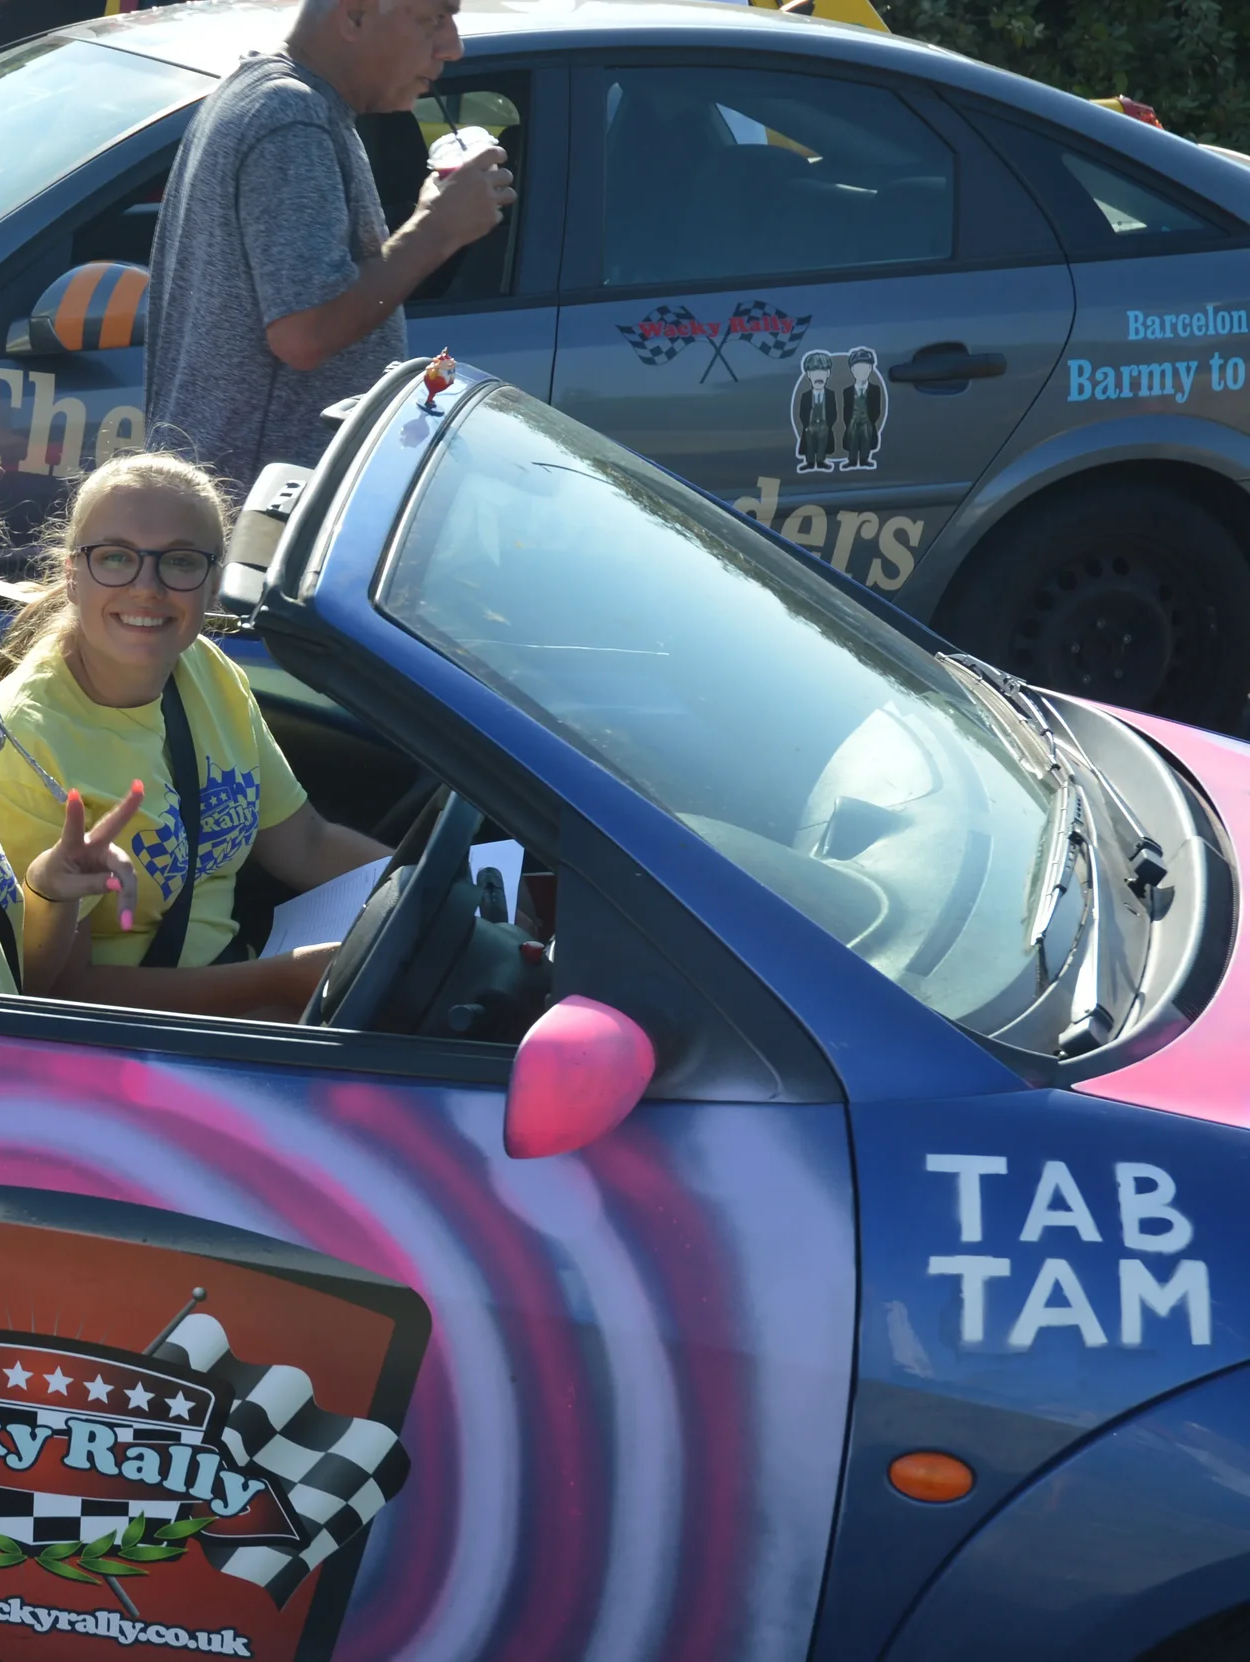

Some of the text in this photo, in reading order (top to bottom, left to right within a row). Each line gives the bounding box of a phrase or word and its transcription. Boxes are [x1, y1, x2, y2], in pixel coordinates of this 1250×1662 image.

[638, 315, 796, 338] Wacky Rally
[1126, 304, 1250, 341] Barcelon
[1067, 352, 1246, 403] Barmy to
[200, 805, 254, 833] Rally
[925, 1153, 1194, 1255] TAB
[927, 1255, 1212, 1348] TAM
[62, 1418, 266, 1516] Rally
